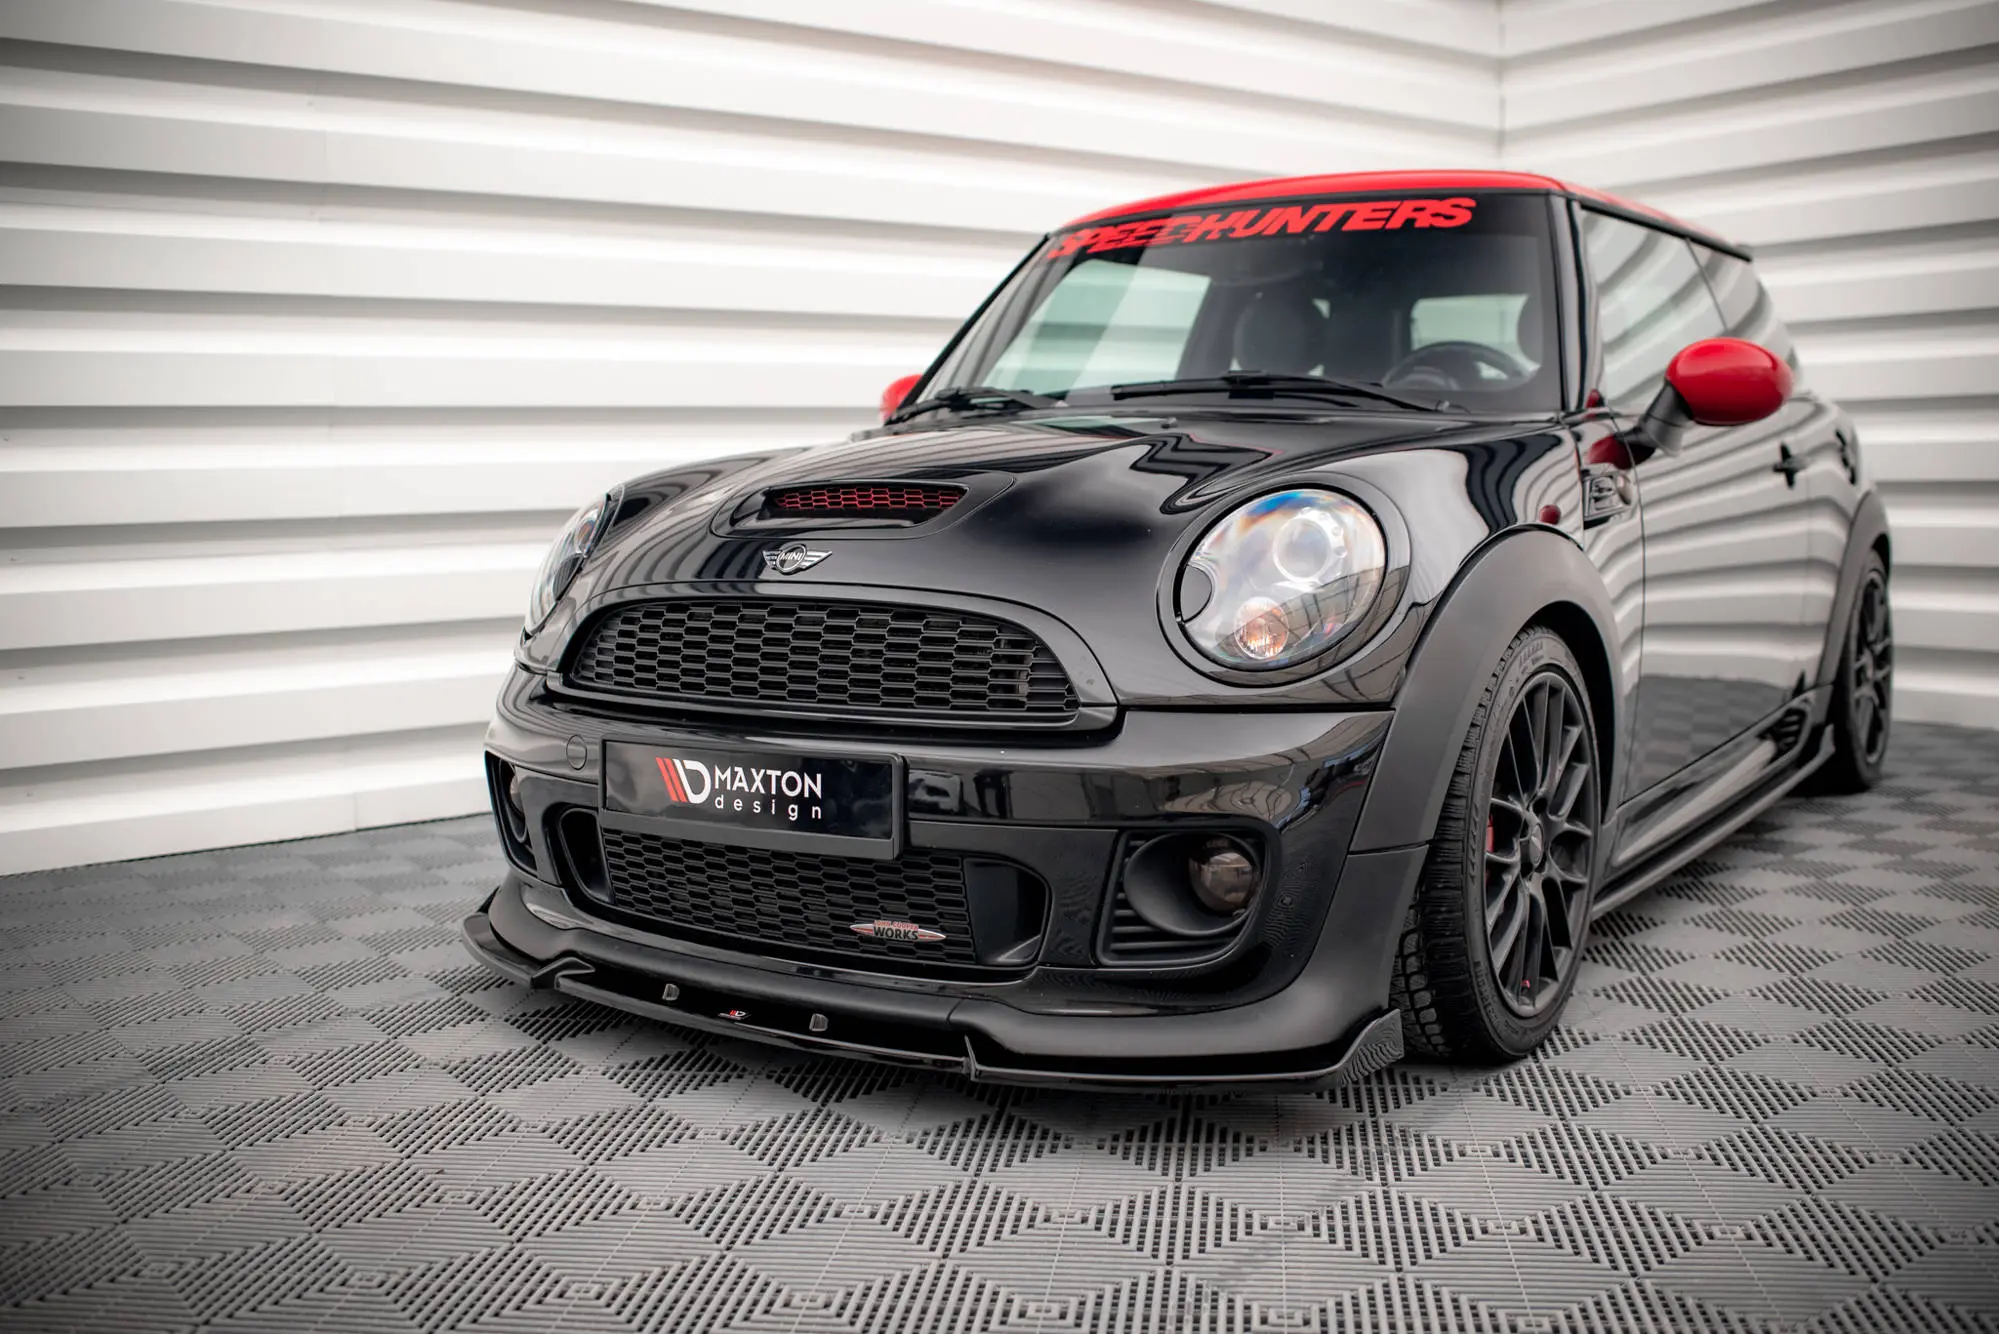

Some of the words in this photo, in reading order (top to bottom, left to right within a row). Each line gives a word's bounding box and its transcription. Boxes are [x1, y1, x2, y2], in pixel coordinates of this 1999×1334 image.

[1047, 197, 1477, 259] SPEEDHUNTERS
[780, 552, 803, 561] MINI
[714, 764, 822, 799] MAXTON
[714, 794, 822, 821] design
[873, 926, 919, 941] WORKS
